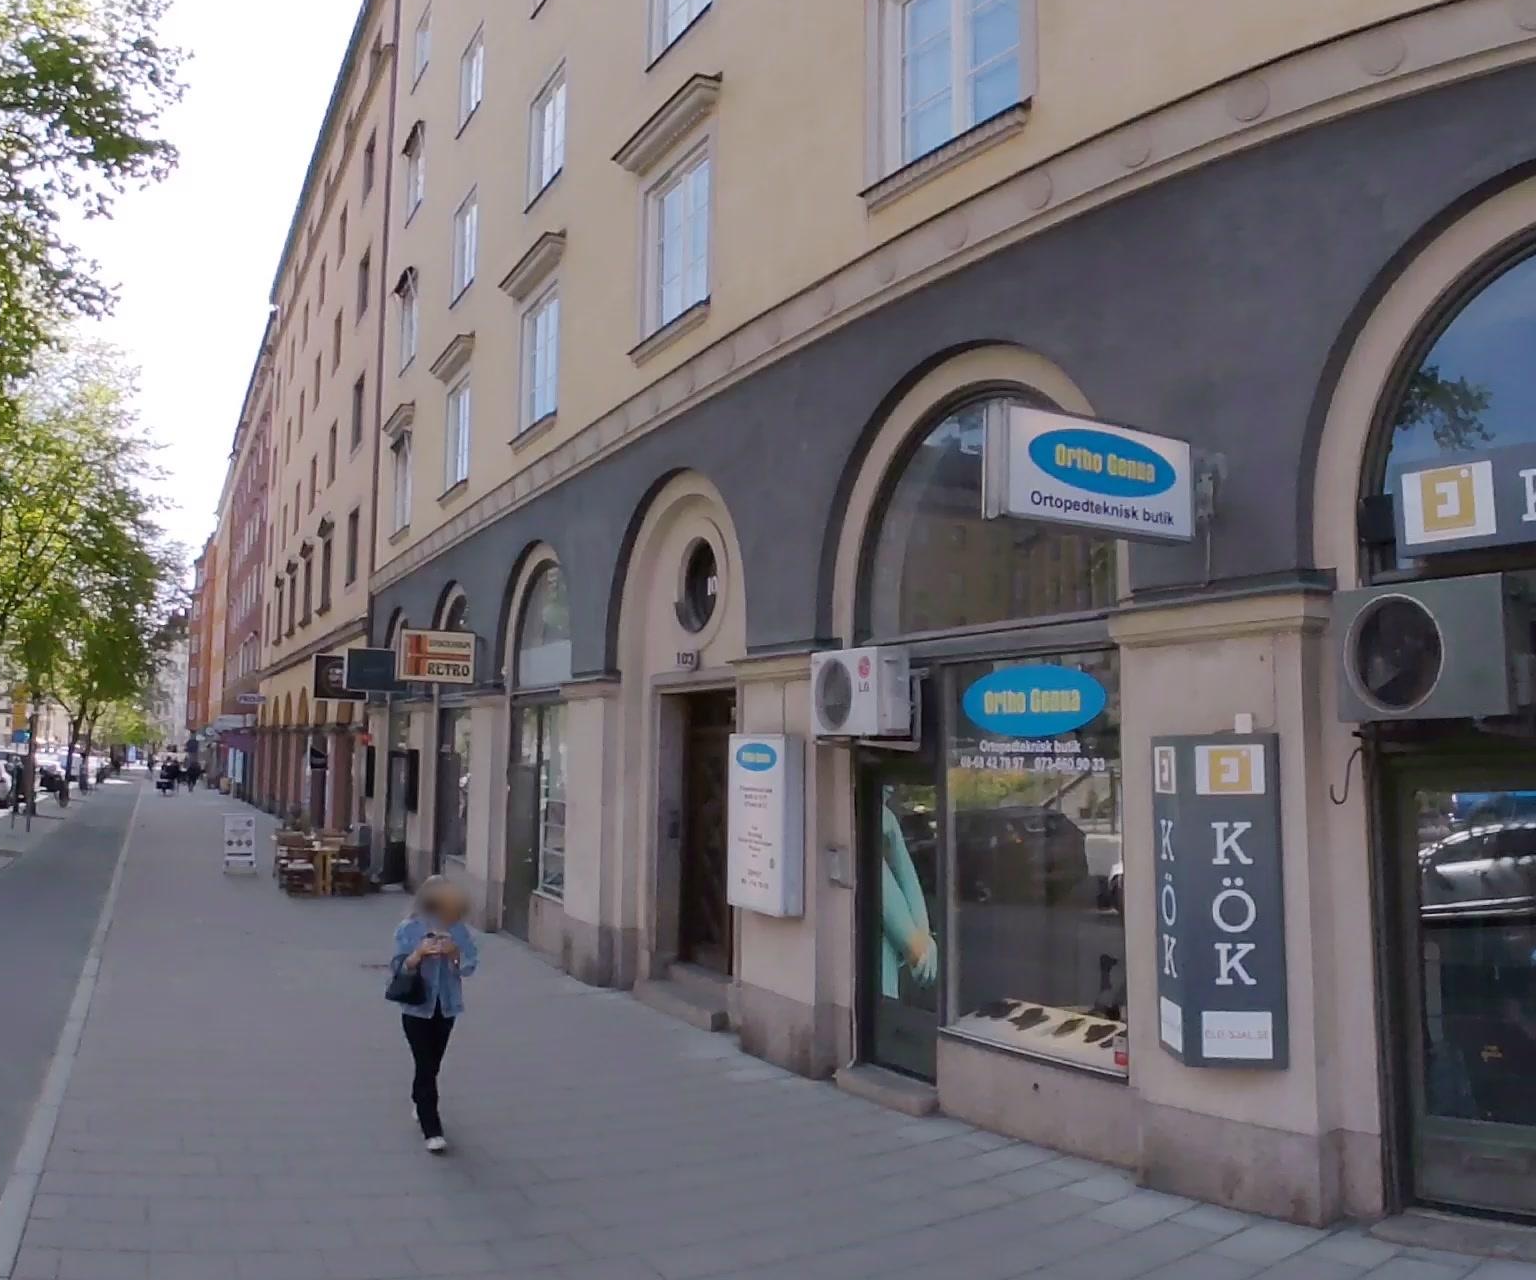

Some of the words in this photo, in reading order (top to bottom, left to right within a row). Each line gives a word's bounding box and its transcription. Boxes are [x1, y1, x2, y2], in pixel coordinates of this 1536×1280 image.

[1054, 443, 1103, 474] Ortho
[1030, 490, 1140, 520] Ortopedteknisk
[1143, 508, 1175, 526] butik
[427, 662, 470, 677] RETRO
[1159, 818, 1178, 979] KÖK
[1210, 821, 1258, 986] KÖK
